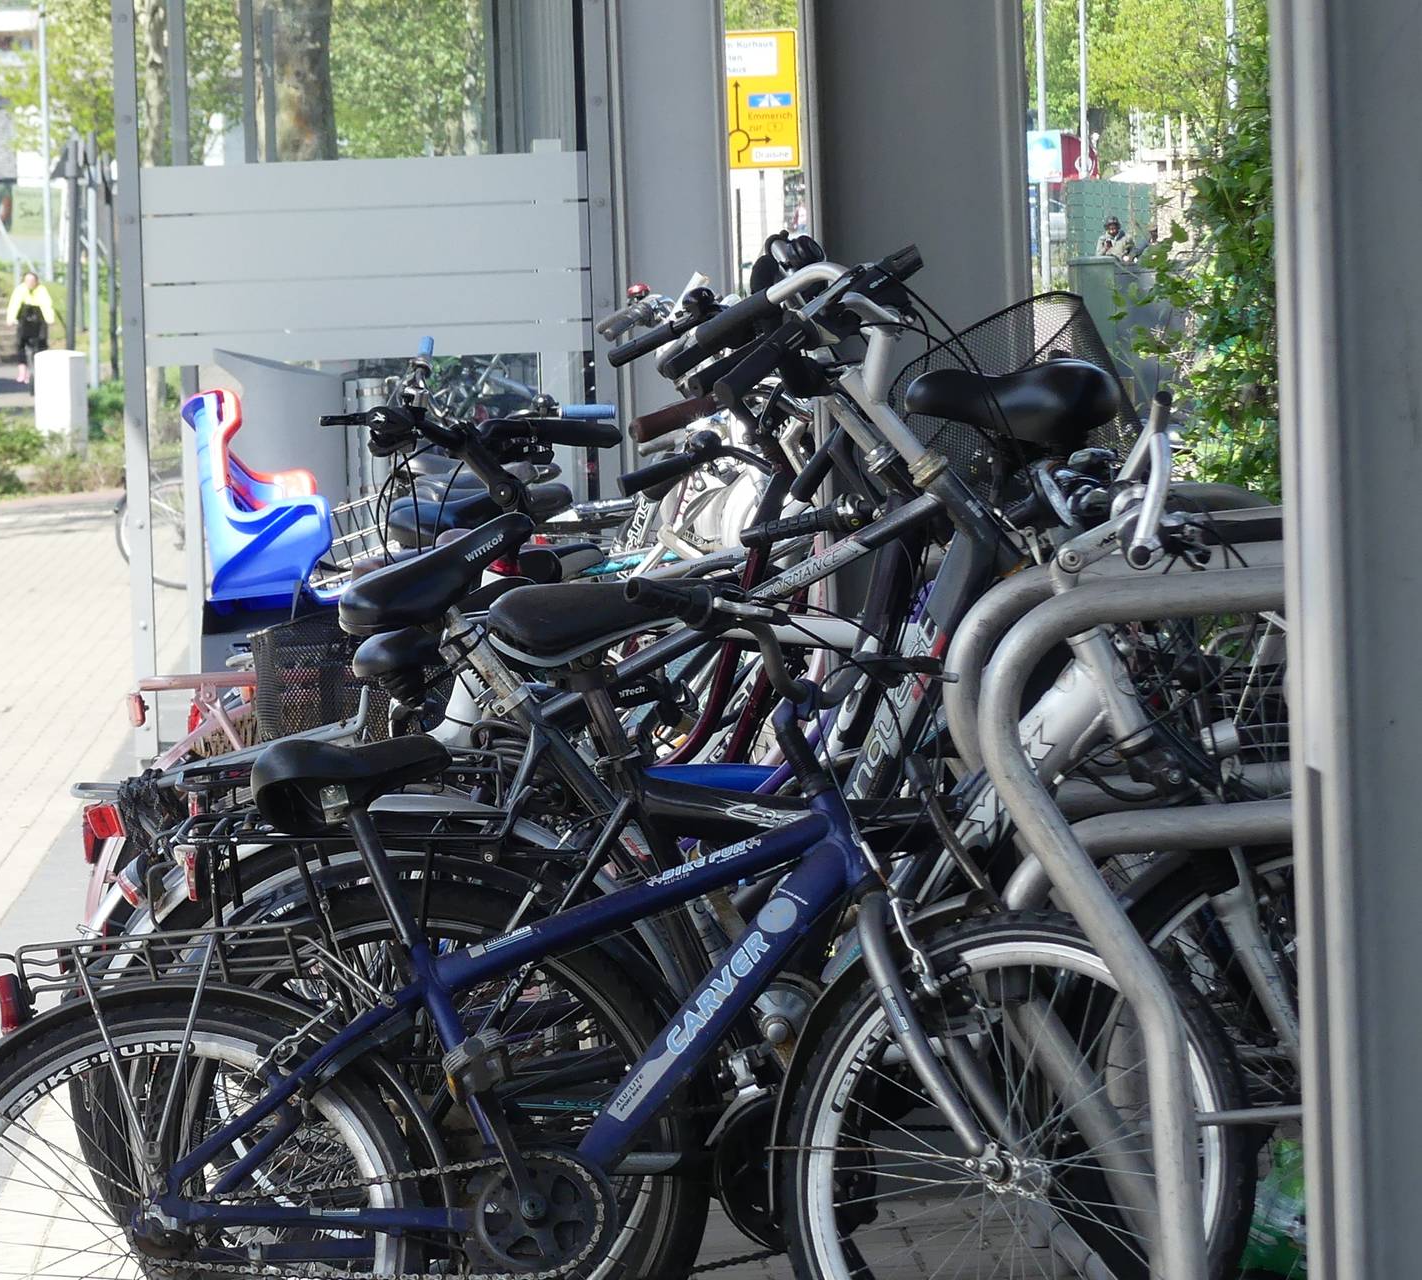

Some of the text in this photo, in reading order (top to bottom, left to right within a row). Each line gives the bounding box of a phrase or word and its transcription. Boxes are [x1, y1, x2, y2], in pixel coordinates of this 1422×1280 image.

[464, 532, 505, 562] WITTKOP
[661, 855, 706, 881] BIKE
[708, 840, 747, 864] FUN
[666, 930, 771, 1055] CARVER
[842, 1020, 890, 1090] BIKE
[21, 1057, 92, 1104] BIKE
